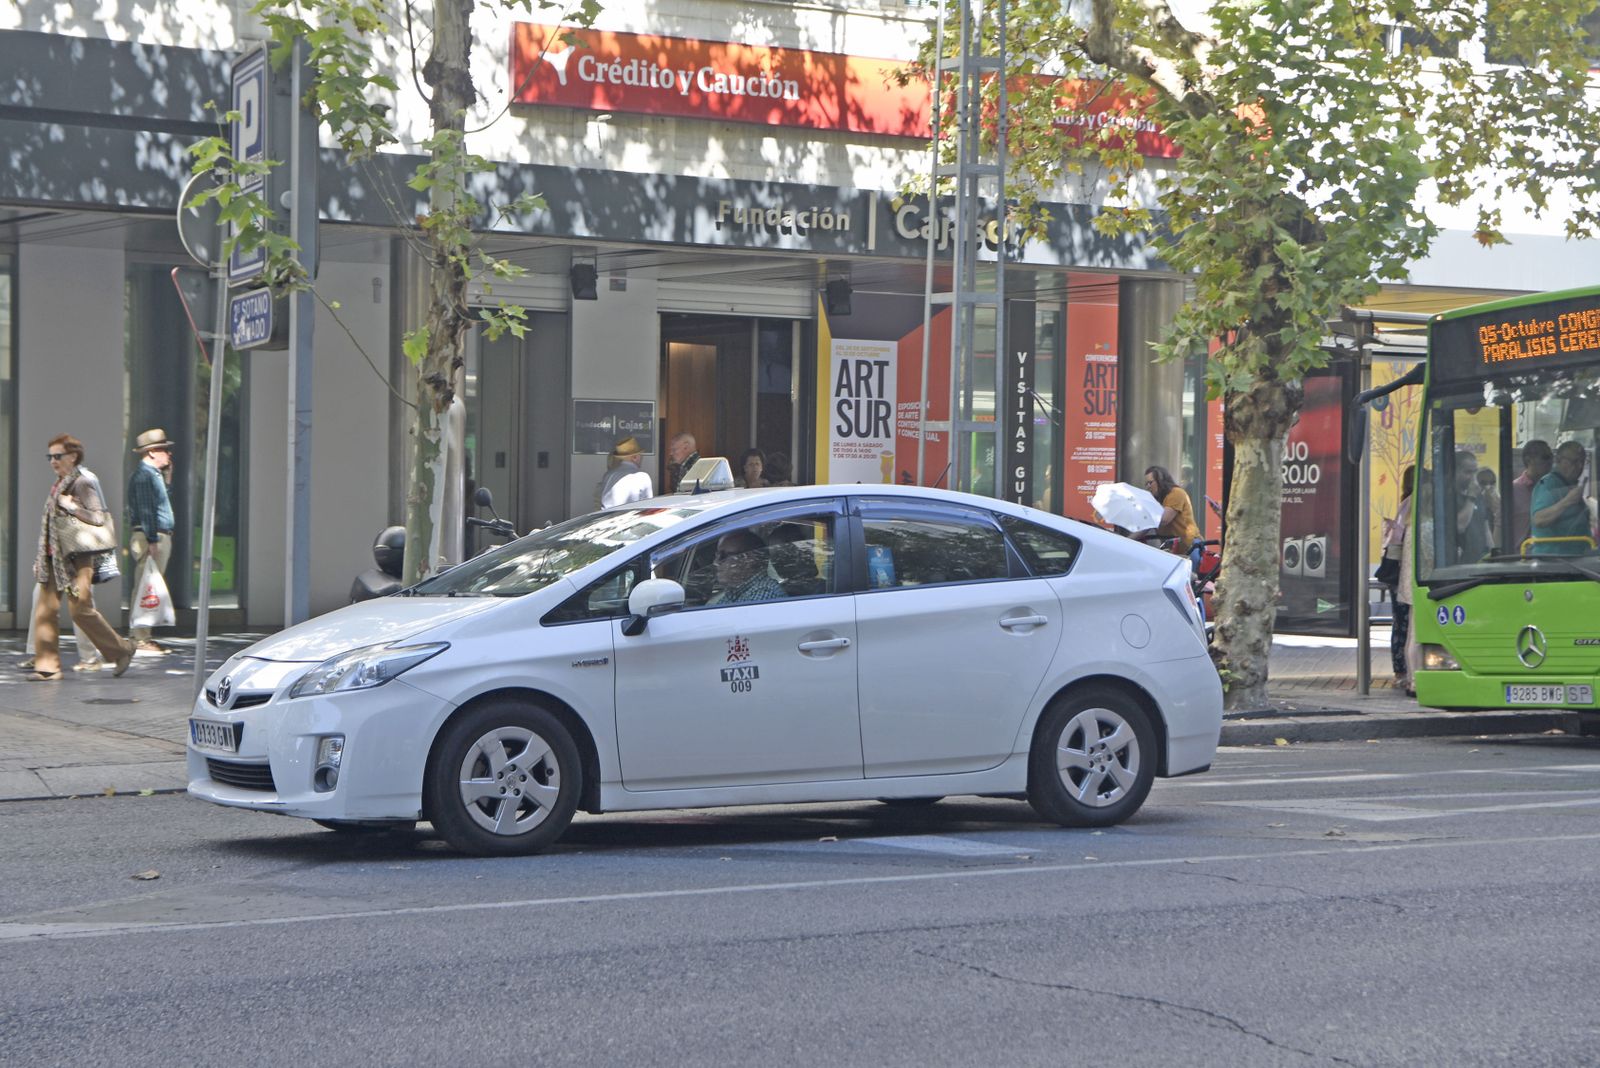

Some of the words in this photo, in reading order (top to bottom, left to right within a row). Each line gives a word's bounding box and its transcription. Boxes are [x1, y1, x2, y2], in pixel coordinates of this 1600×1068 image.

[578, 55, 674, 88] Crédito
[679, 70, 695, 95] y
[697, 66, 800, 100] Caución
[718, 200, 850, 231] Fundación
[1483, 335, 1557, 364] PARALISIS
[1560, 330, 1600, 352] CERE
[835, 359, 889, 399] ART
[1083, 362, 1118, 388] ART
[898, 401, 930, 411] EXPOSICN
[1016, 352, 1027, 453] VISITAS
[836, 399, 891, 439] SUR
[902, 430, 941, 442] CONCEUAL
[1281, 464, 1320, 484] ROJO
[724, 668, 755, 680] TAXI
[731, 680, 752, 693] 009
[1512, 687, 1538, 702] 9285
[1568, 686, 1590, 702] SP
